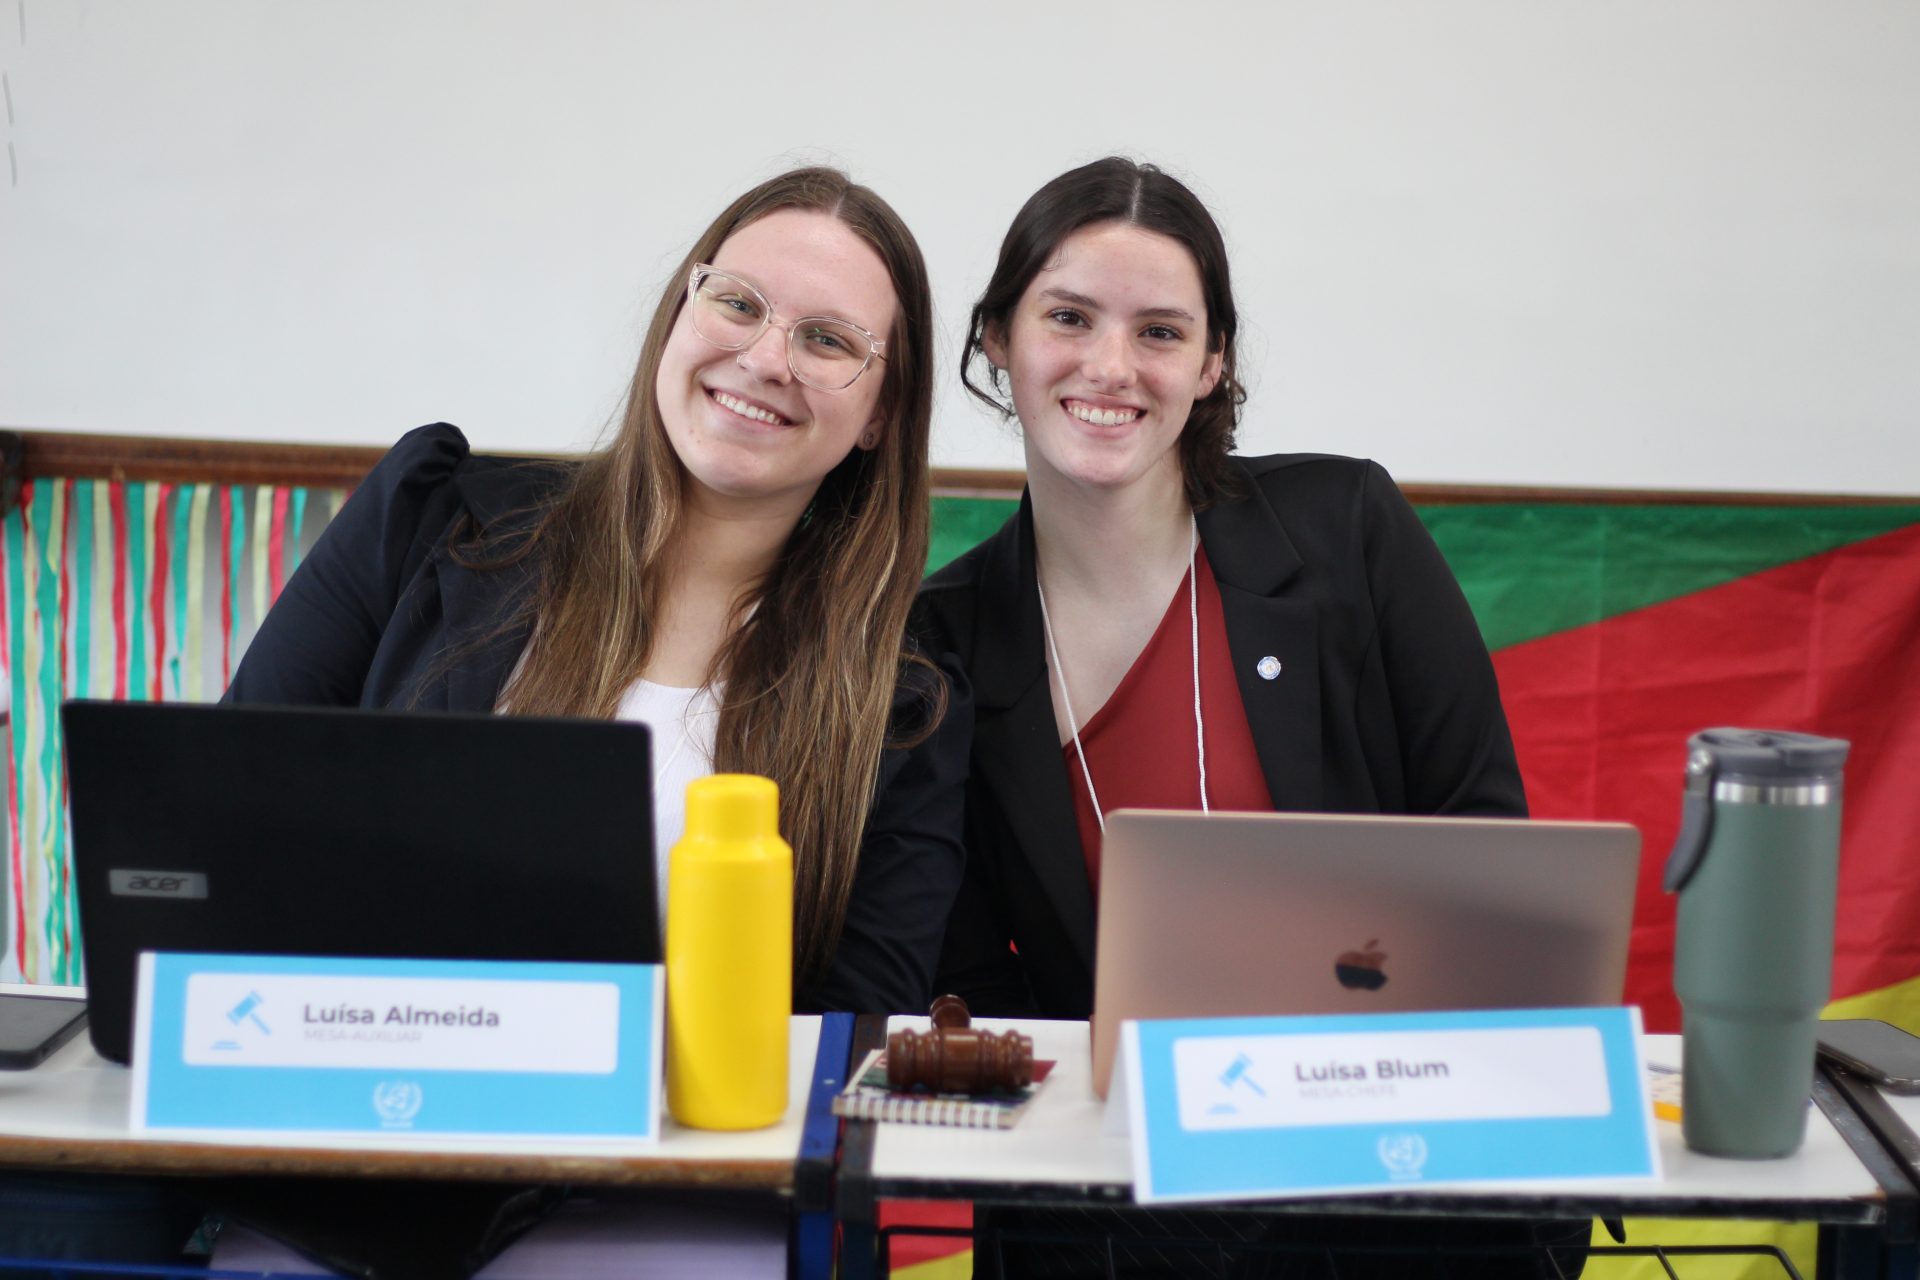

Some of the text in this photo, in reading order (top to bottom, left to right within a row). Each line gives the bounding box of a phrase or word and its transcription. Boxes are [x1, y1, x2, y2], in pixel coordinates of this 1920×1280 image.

[128, 876, 189, 891] acer
[303, 1001, 500, 1027] Luísa Almeida
[1376, 1059, 1450, 1079] Blum
